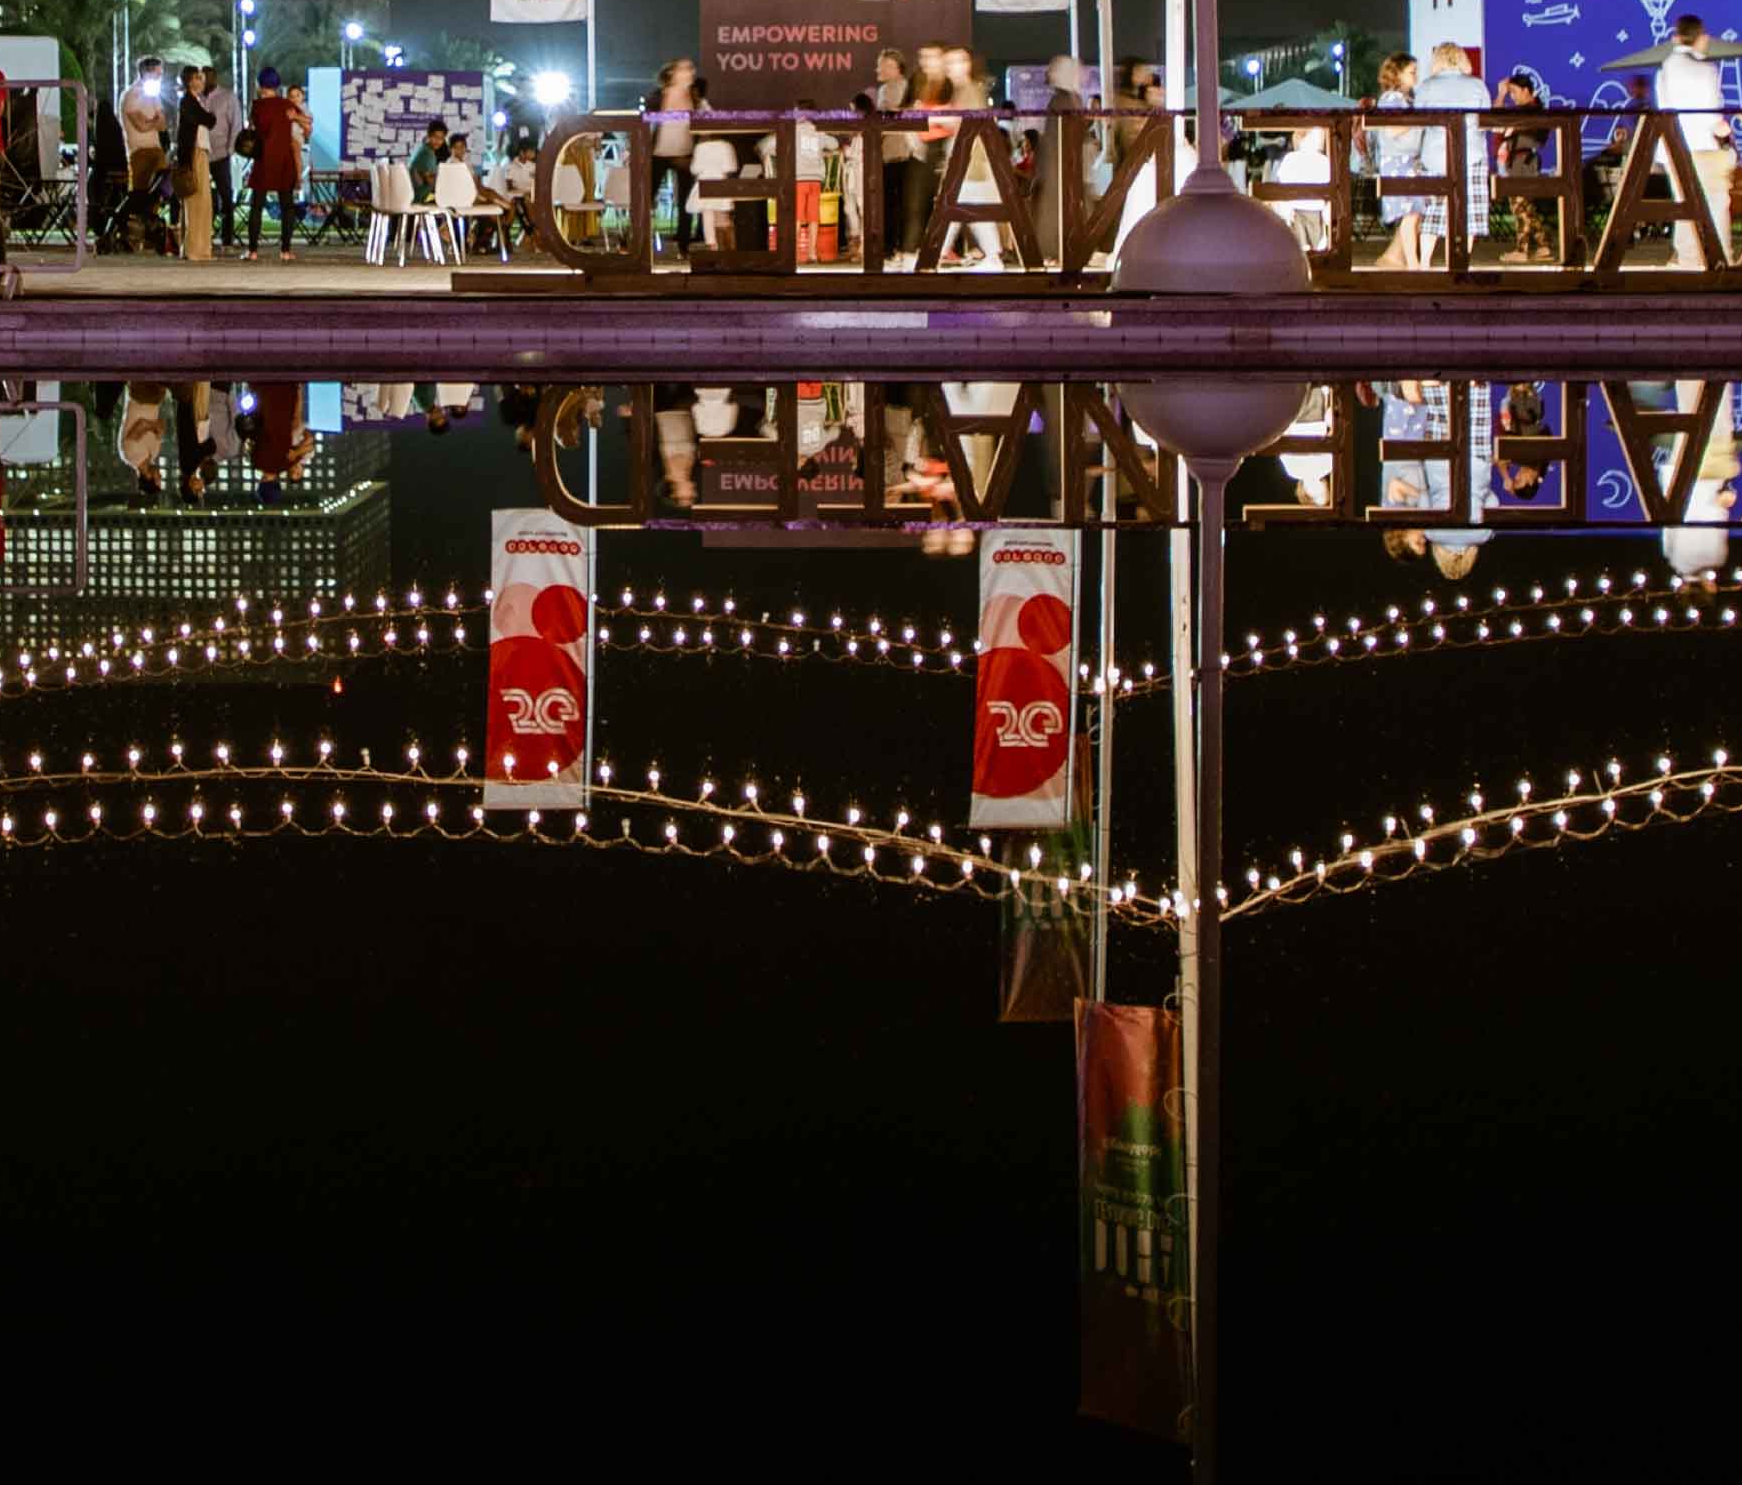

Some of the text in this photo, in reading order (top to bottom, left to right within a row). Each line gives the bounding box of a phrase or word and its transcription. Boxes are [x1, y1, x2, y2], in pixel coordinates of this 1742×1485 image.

[717, 24, 878, 43] EMPOWERING
[716, 52, 852, 71] YOU TO WIN
